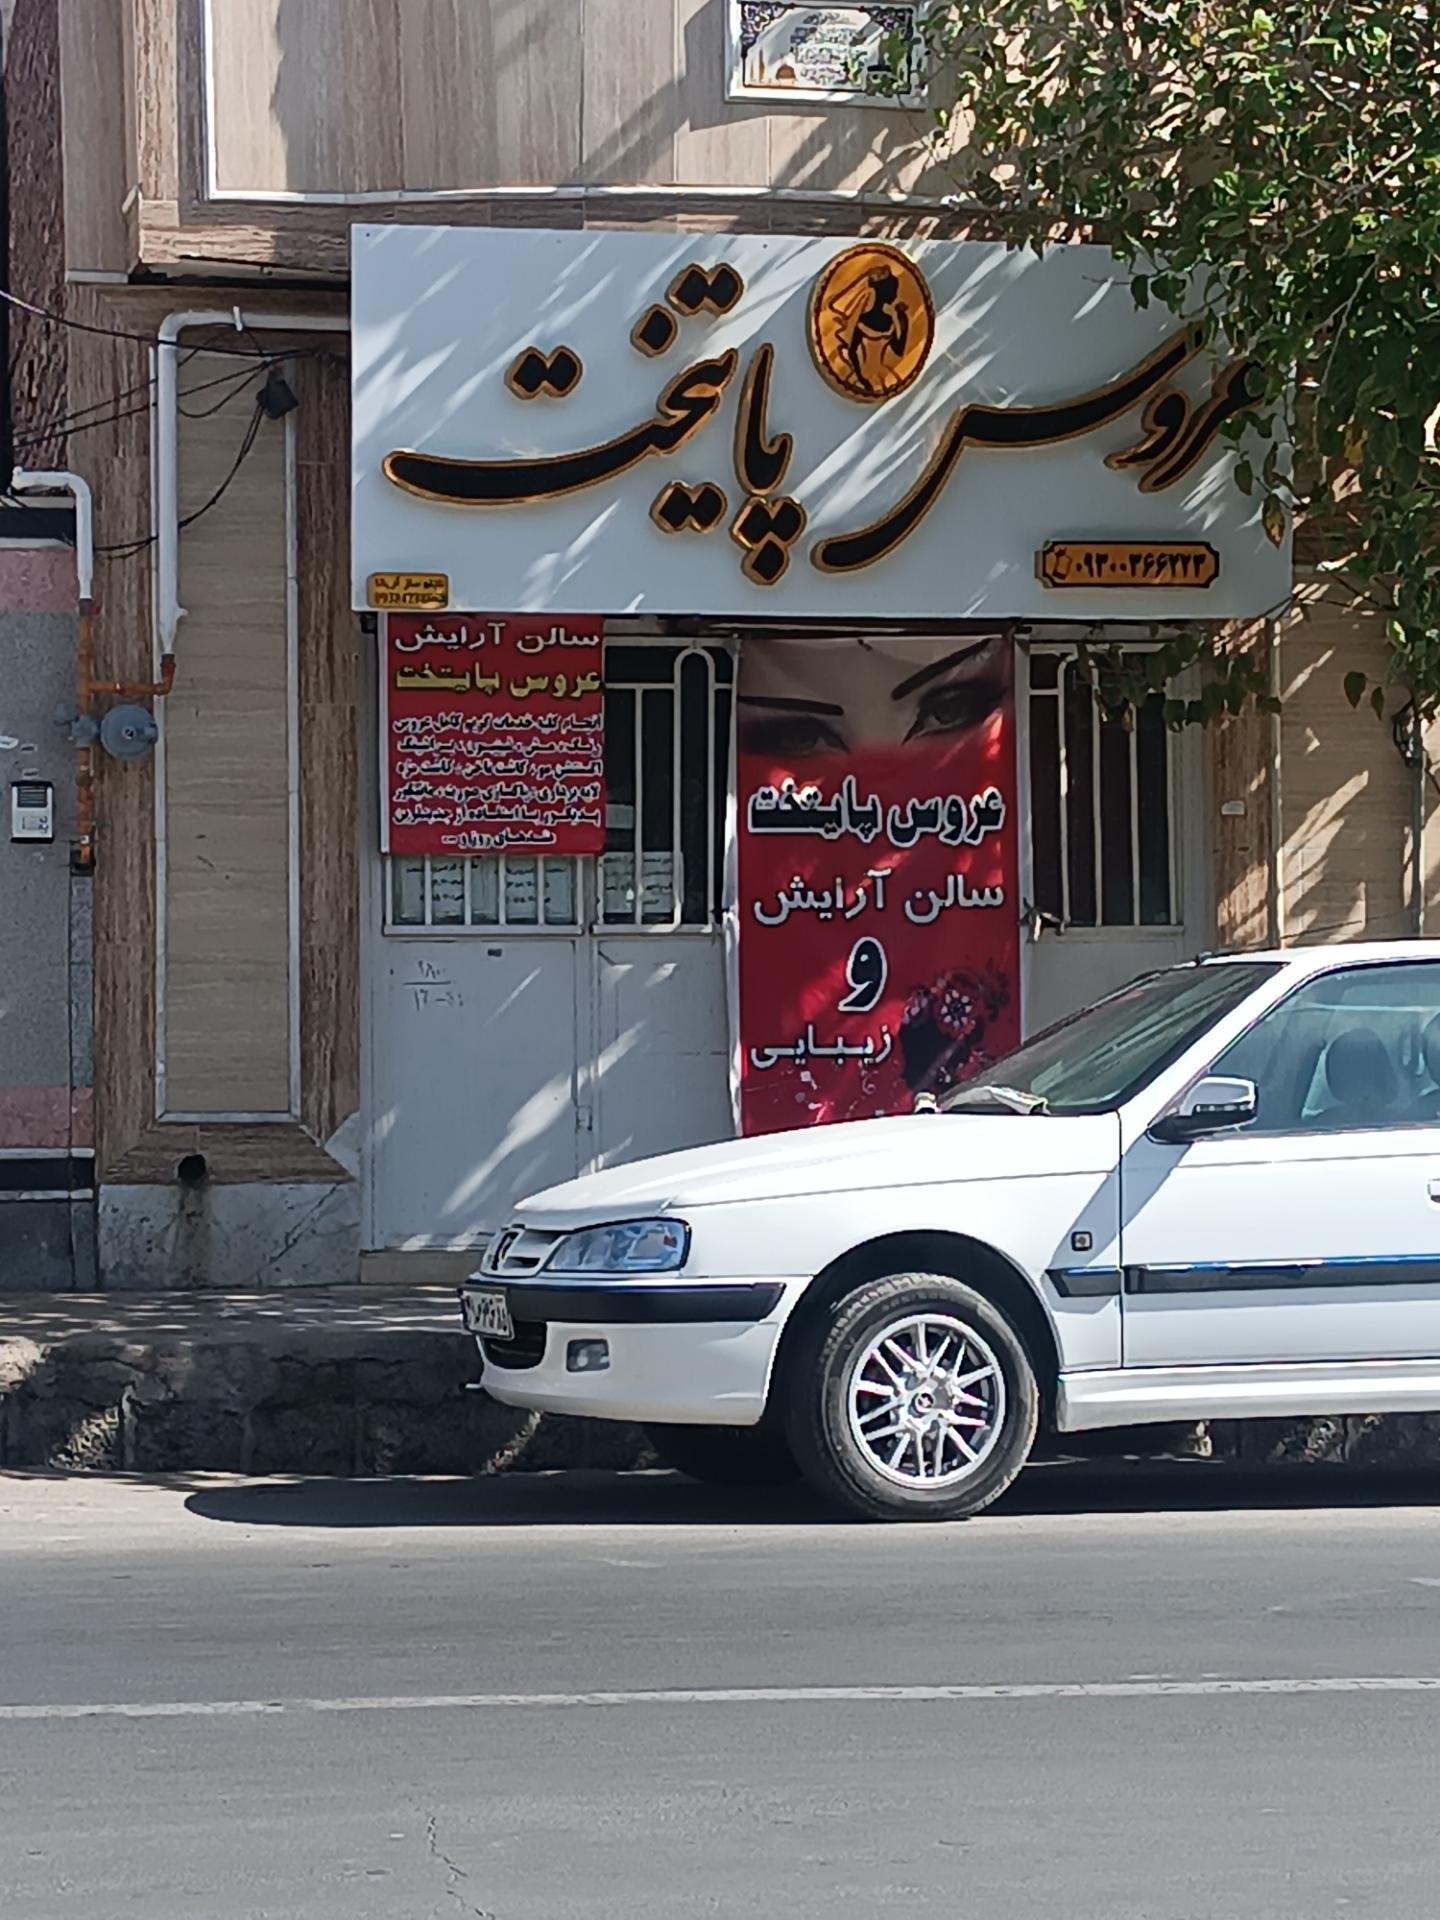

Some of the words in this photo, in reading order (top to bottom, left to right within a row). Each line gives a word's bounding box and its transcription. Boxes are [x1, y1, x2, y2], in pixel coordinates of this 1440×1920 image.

[382, 262, 807, 586] پایتخت
[394, 621, 506, 652] آرایش
[516, 626, 600, 654] سالن
[396, 661, 500, 695] پایتخت
[509, 670, 601, 698] عروس
[747, 775, 883, 843] پایتخت
[886, 786, 1006, 848] عروس
[753, 868, 892, 926] آرایش
[904, 874, 1005, 924] سالن
[838, 936, 888, 1012] و
[751, 1023, 893, 1070] زیبایی
